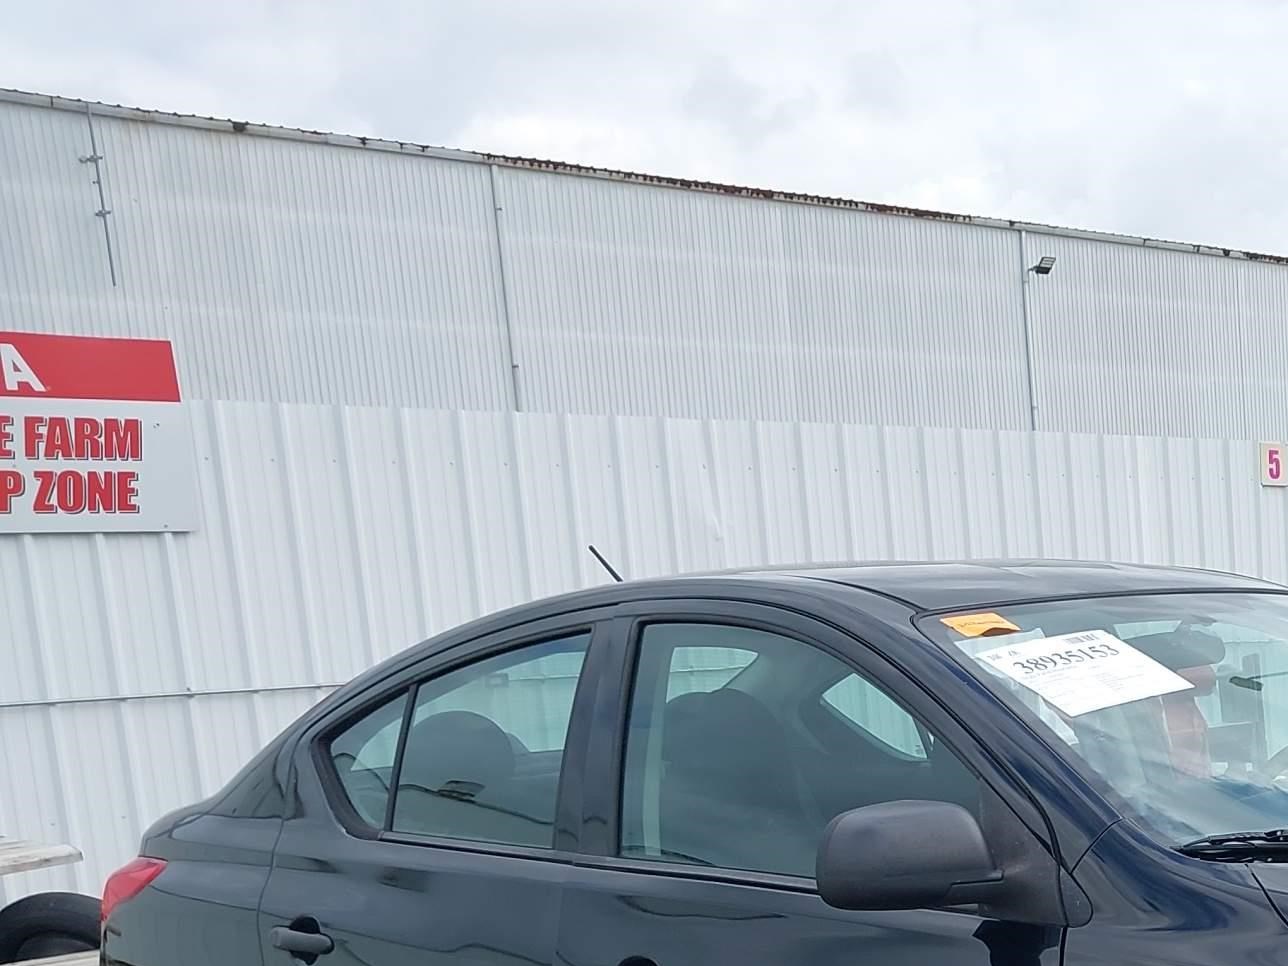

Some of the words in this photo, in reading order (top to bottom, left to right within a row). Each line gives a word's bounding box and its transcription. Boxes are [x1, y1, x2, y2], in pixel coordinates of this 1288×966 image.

[24, 415, 143, 461] FARM
[1268, 449, 1281, 480] 5
[0, 470, 25, 514] P
[33, 470, 140, 514] ZONE
[1013, 644, 1120, 675] 38935153
